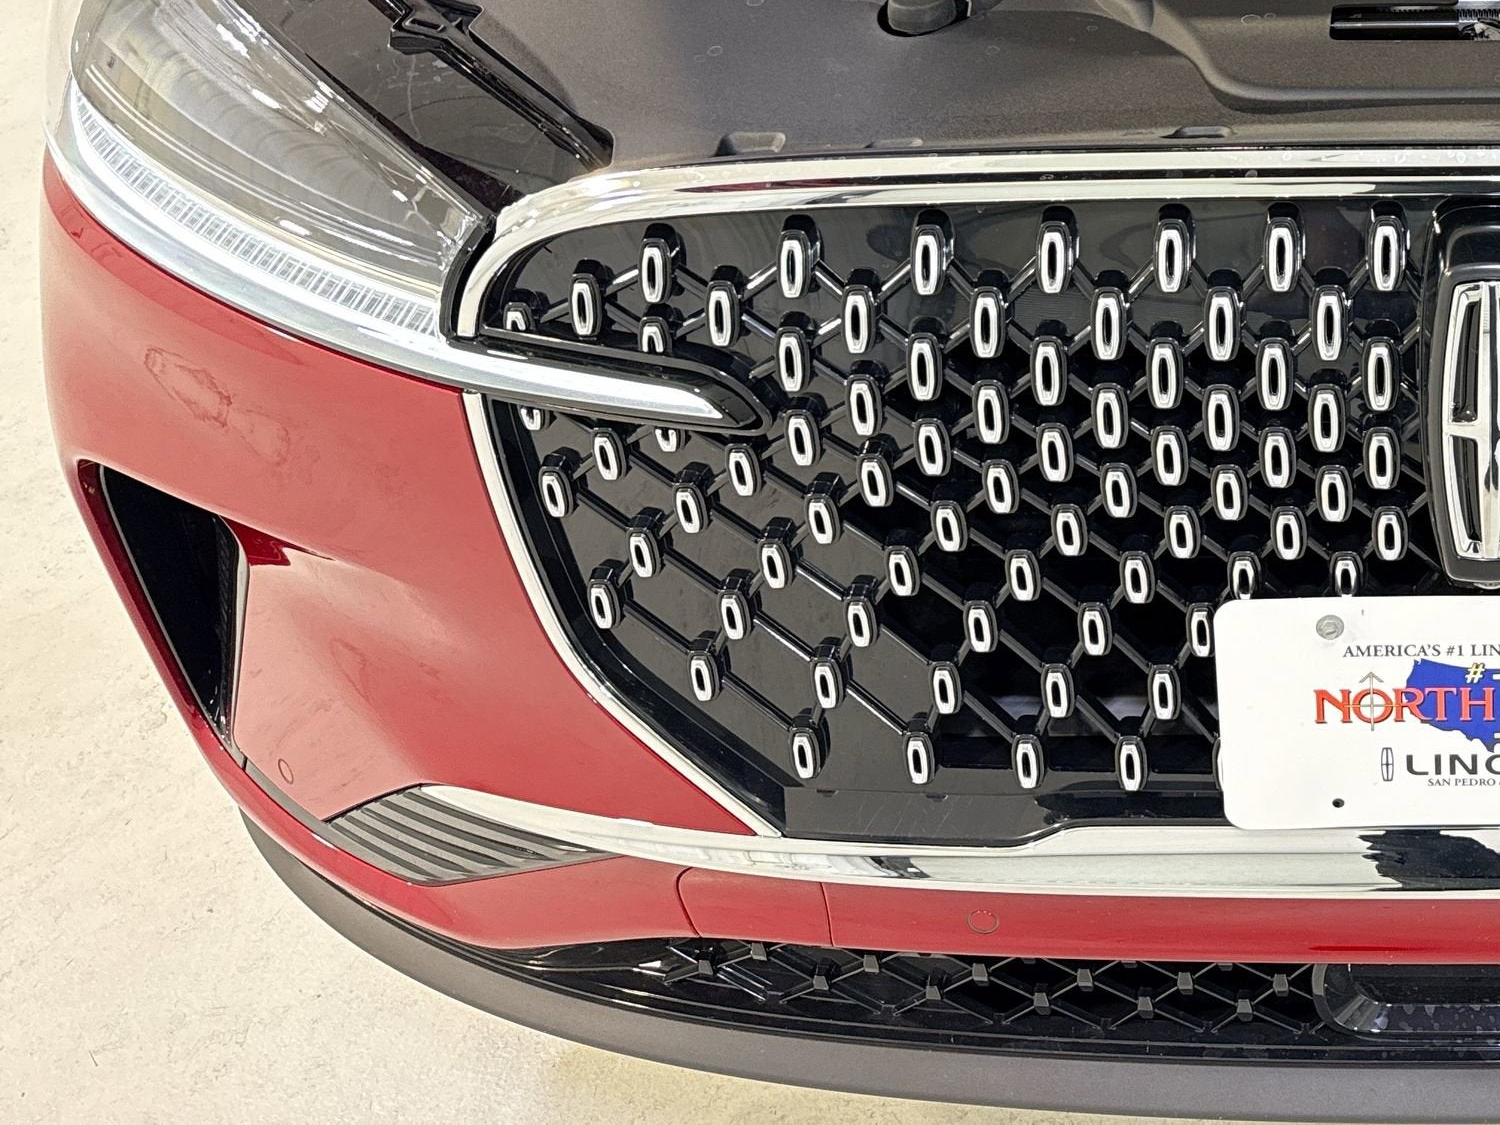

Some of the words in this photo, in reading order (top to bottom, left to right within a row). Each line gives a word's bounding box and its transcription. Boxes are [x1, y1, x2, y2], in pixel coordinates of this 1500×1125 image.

[1342, 643, 1442, 658] AMERICA'S
[1445, 644, 1464, 657] #1
[1313, 686, 1496, 725] NORTH
[1427, 778, 1453, 787] SAN
[1454, 777, 1497, 787] PEDRO
